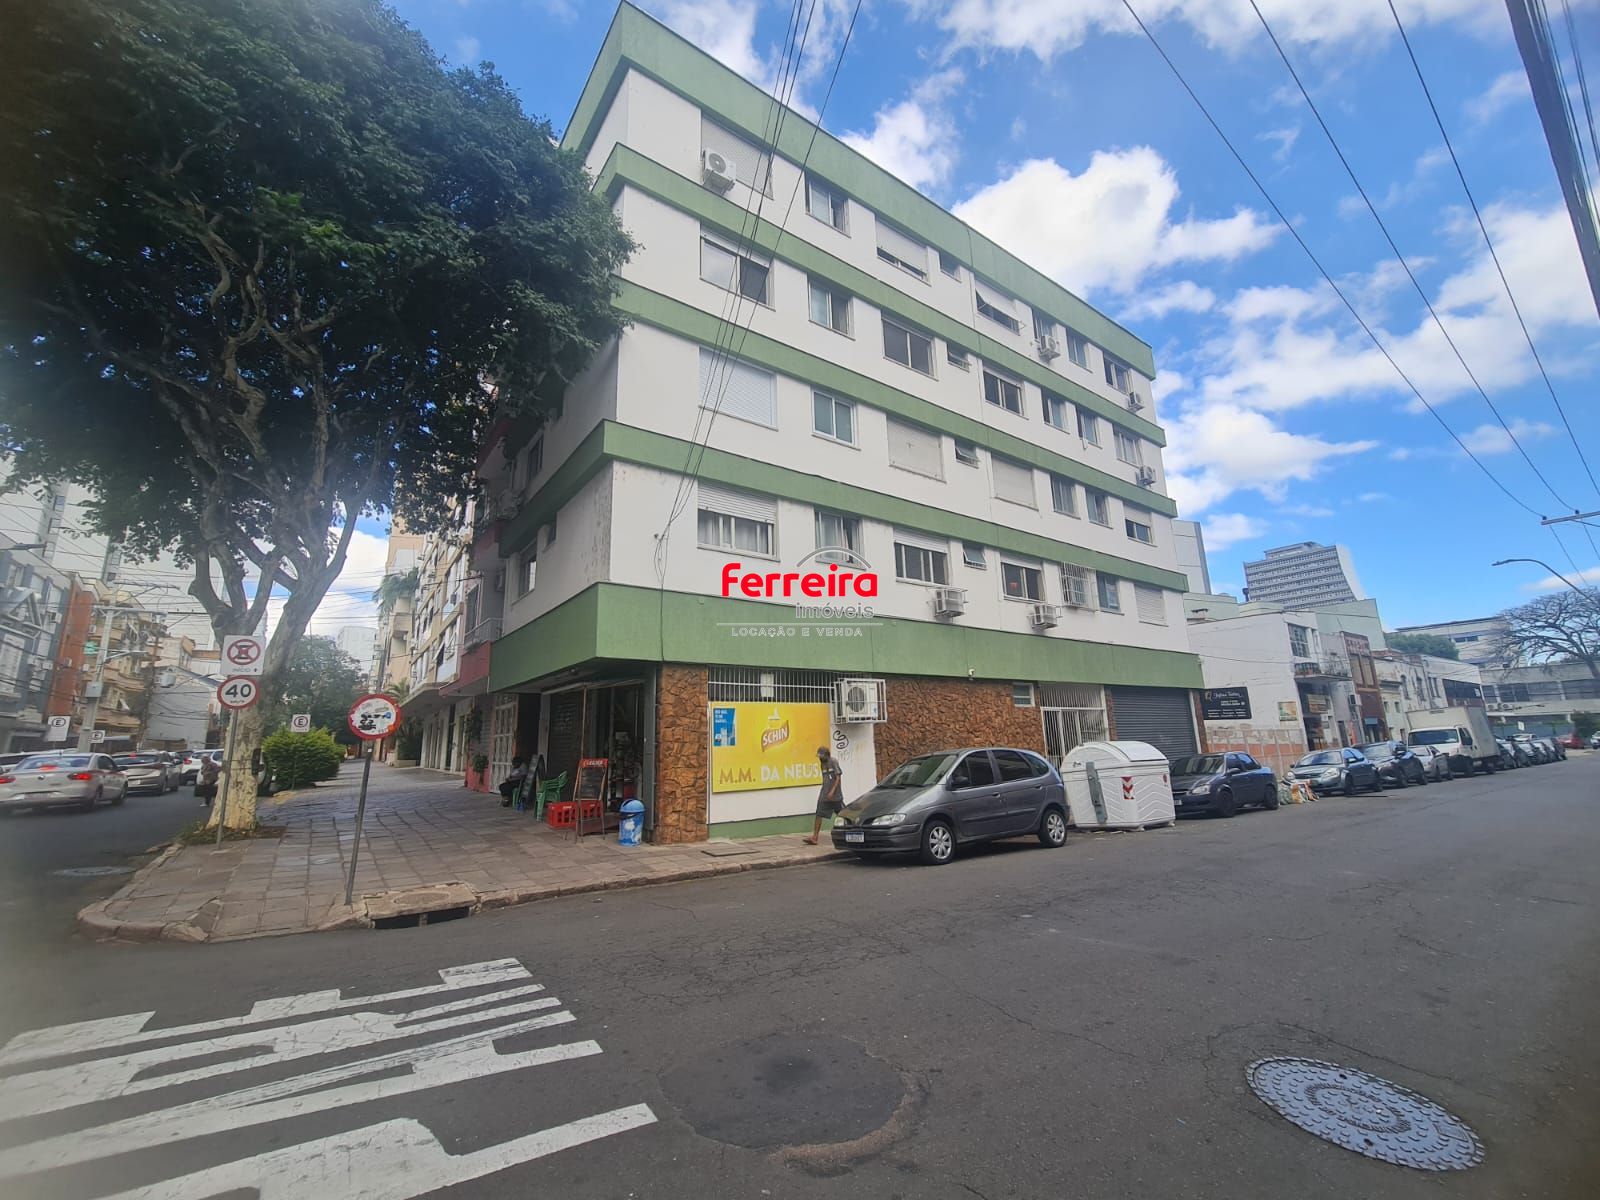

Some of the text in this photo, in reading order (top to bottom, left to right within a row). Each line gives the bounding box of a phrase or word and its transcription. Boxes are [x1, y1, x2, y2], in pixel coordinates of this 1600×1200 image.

[225, 683, 252, 698] 40
[762, 727, 788, 746] SCHIN
[719, 763, 822, 785] M.M. DA NEUS
